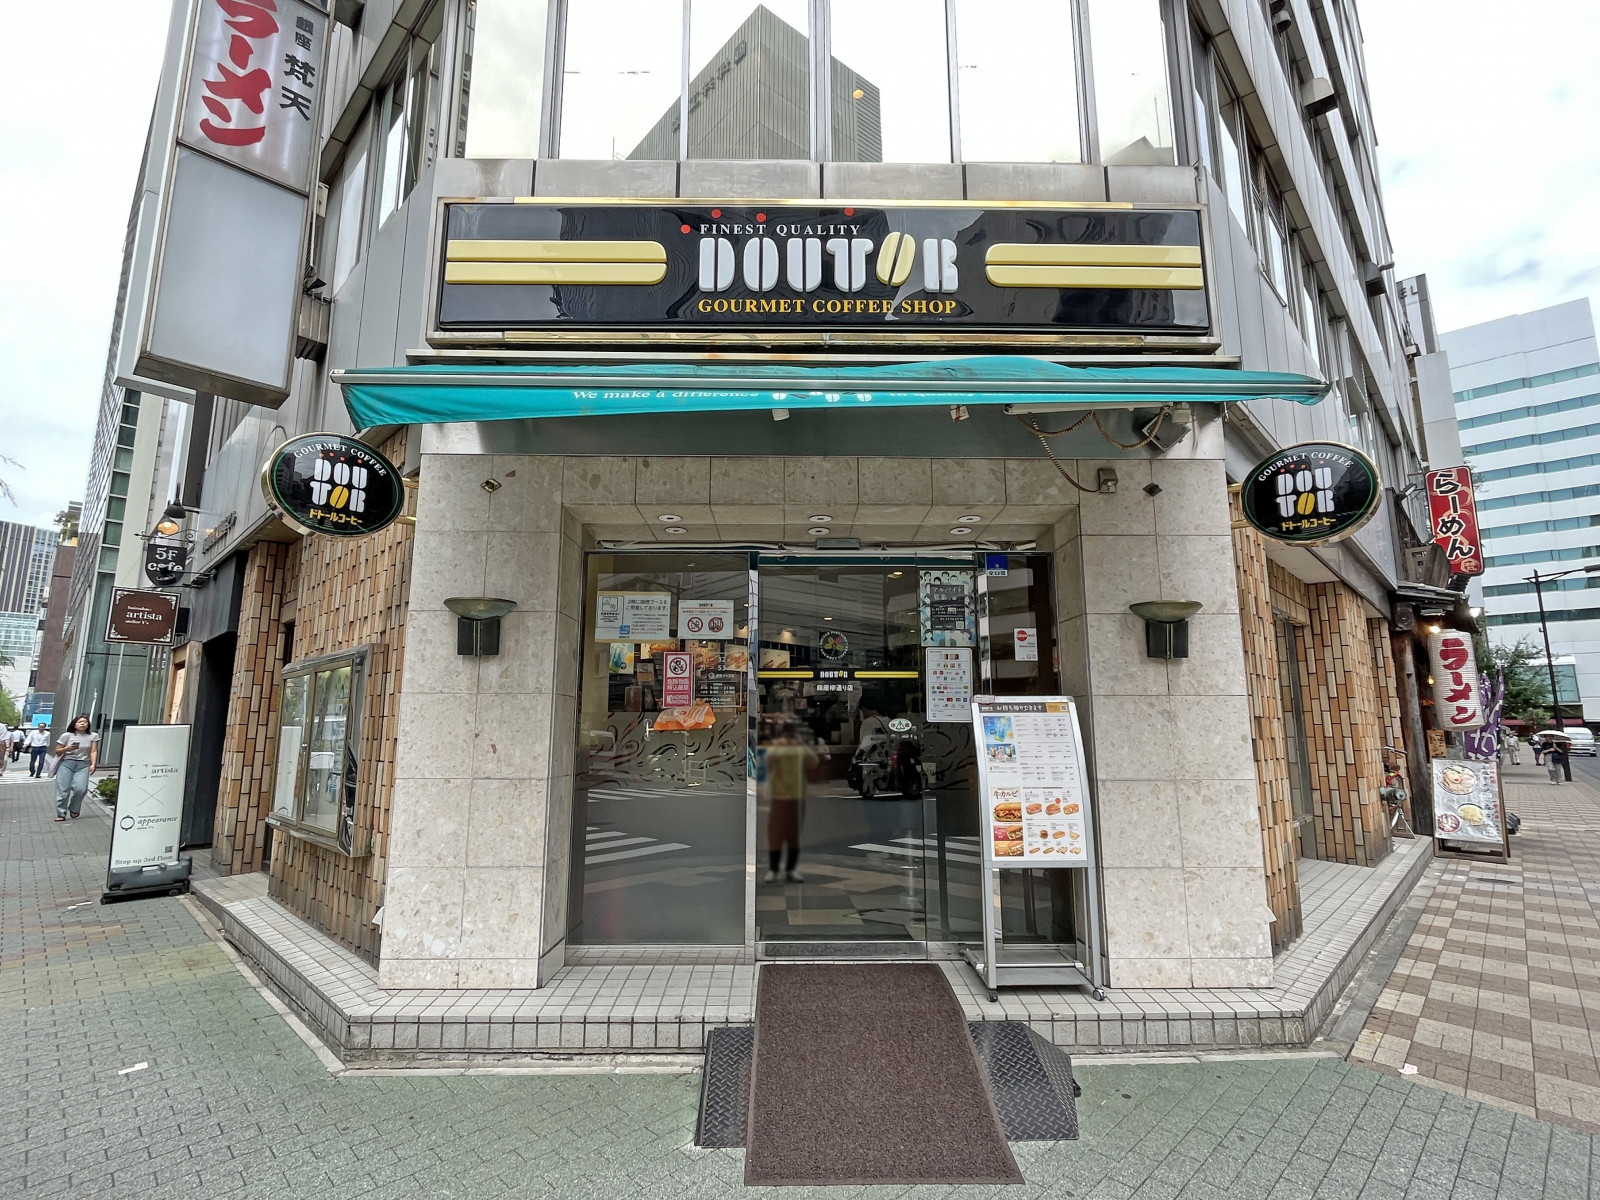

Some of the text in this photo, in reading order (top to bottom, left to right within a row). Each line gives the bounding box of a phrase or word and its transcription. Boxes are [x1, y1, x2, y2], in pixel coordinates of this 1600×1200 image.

[699, 223, 862, 237] FINEST QUALITY
[699, 231, 960, 294] DOUTOR
[698, 299, 958, 315] GOURMET COFFEE SHOP
[572, 390, 598, 400] We
[603, 390, 651, 400] make
[656, 390, 666, 399] a
[293, 442, 388, 477] GOURMET COFFEE
[1258, 451, 1355, 482] GOURMET COFFEE
[308, 507, 363, 526] ドトールコーヒー
[1433, 471, 1476, 560] らーめん
[1281, 516, 1337, 531] ドトールコーヒー
[155, 547, 179, 561] 5F
[125, 611, 163, 621] artista
[819, 670, 848, 679] DOUTOR
[1438, 637, 1477, 725] ラーメン
[137, 816, 178, 827] appearance
